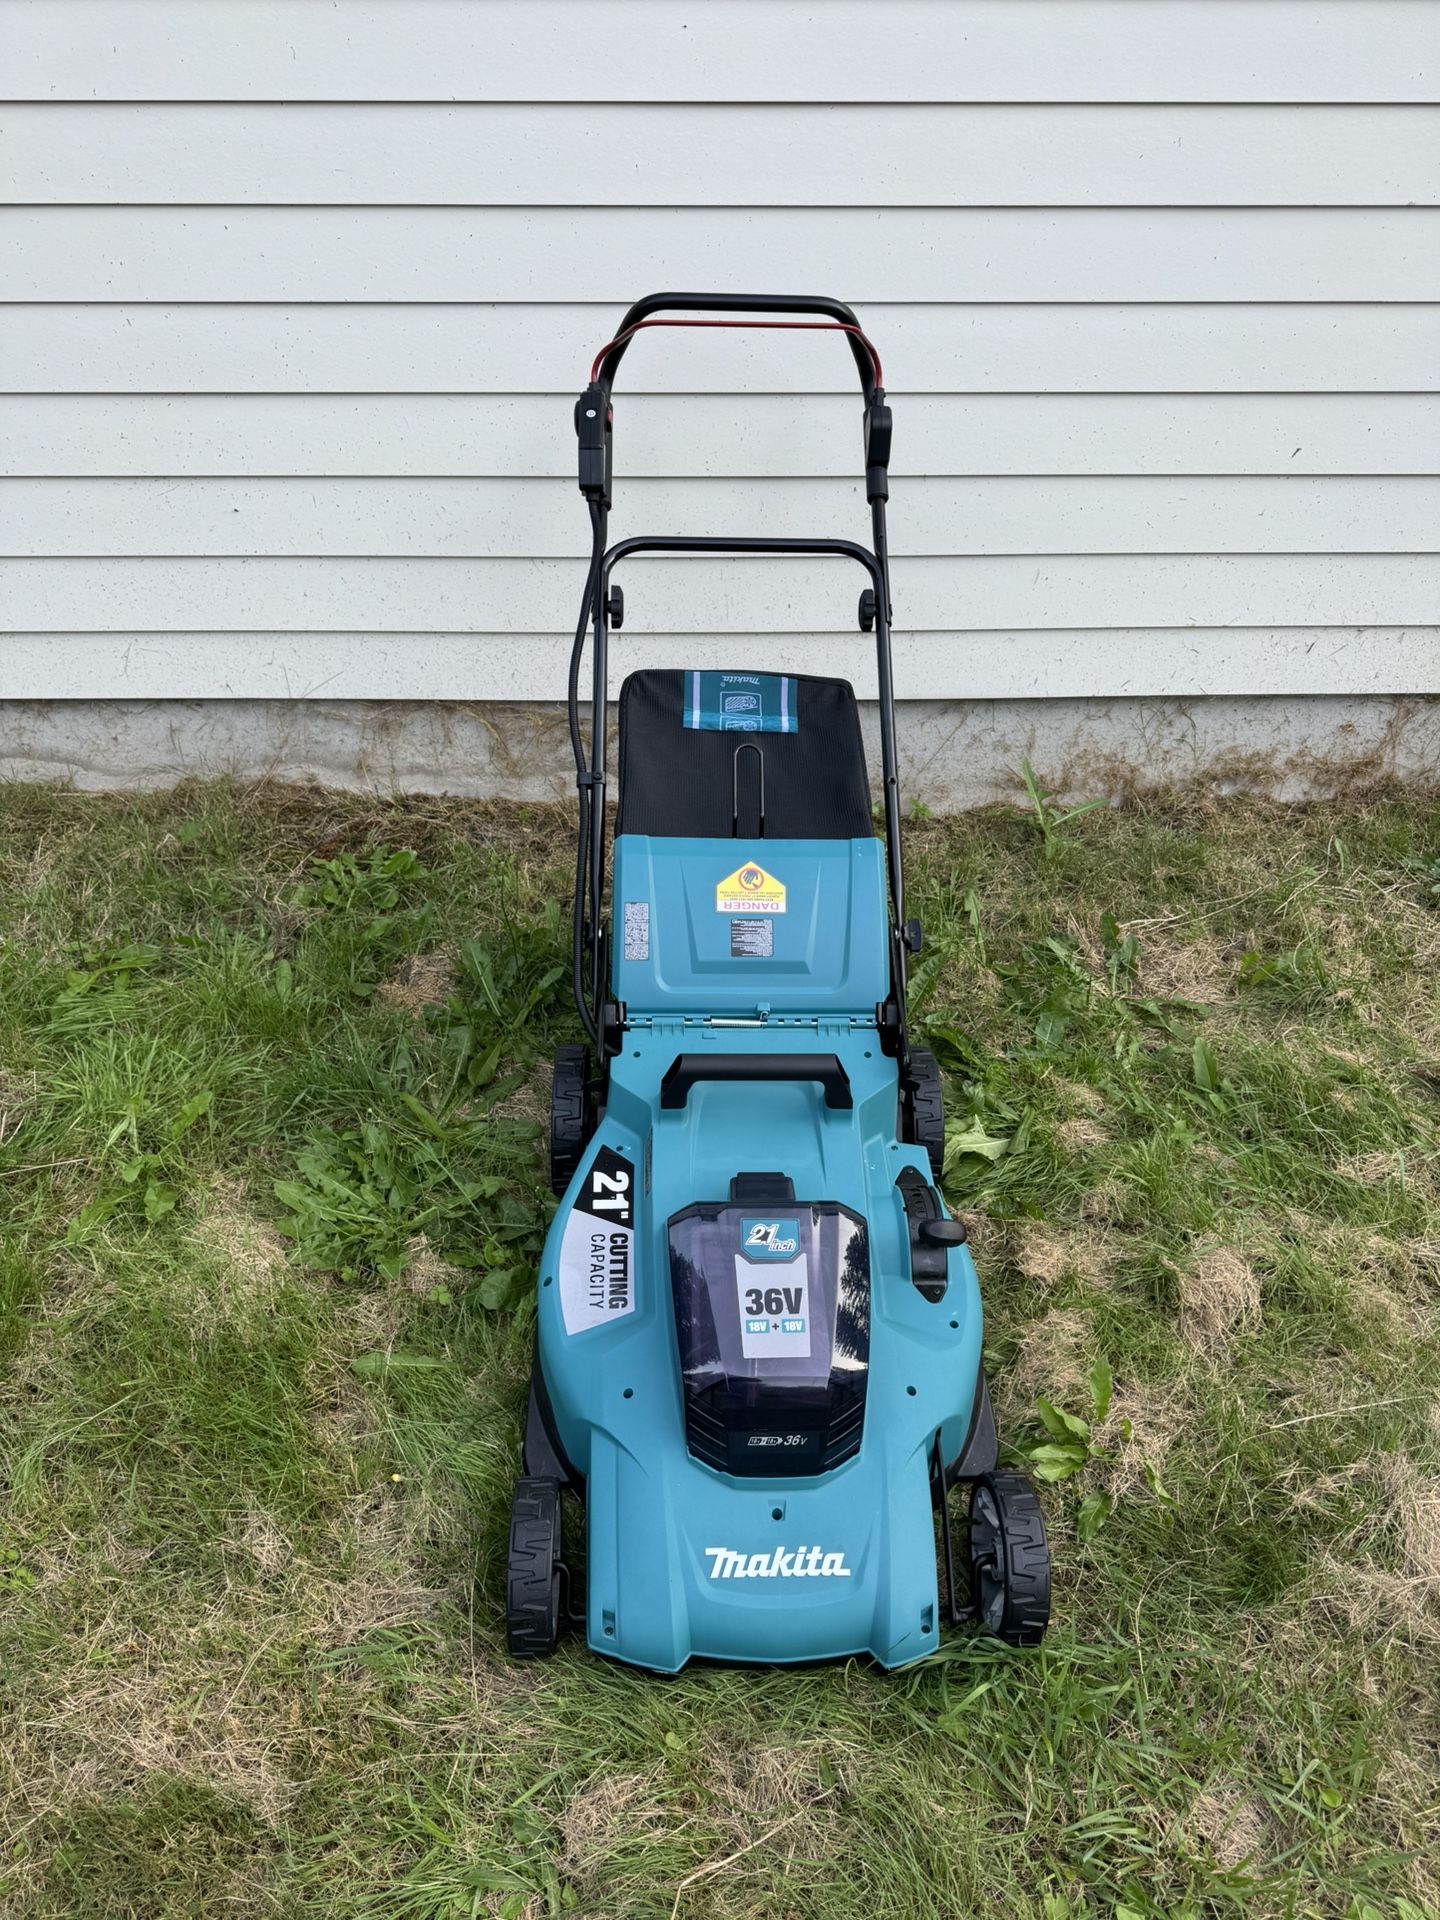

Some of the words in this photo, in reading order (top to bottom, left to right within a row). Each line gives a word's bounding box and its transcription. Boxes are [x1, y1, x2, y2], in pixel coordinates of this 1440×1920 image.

[723, 901, 780, 910] DANGER
[745, 1223, 780, 1246] 21
[589, 1233, 606, 1309] CAPACITY
[608, 1232, 629, 1309] CUTTING
[745, 1287, 803, 1316] 36V
[748, 1321, 767, 1332] 18V
[784, 1321, 803, 1332] 18V
[705, 1546, 852, 1579] Makita
